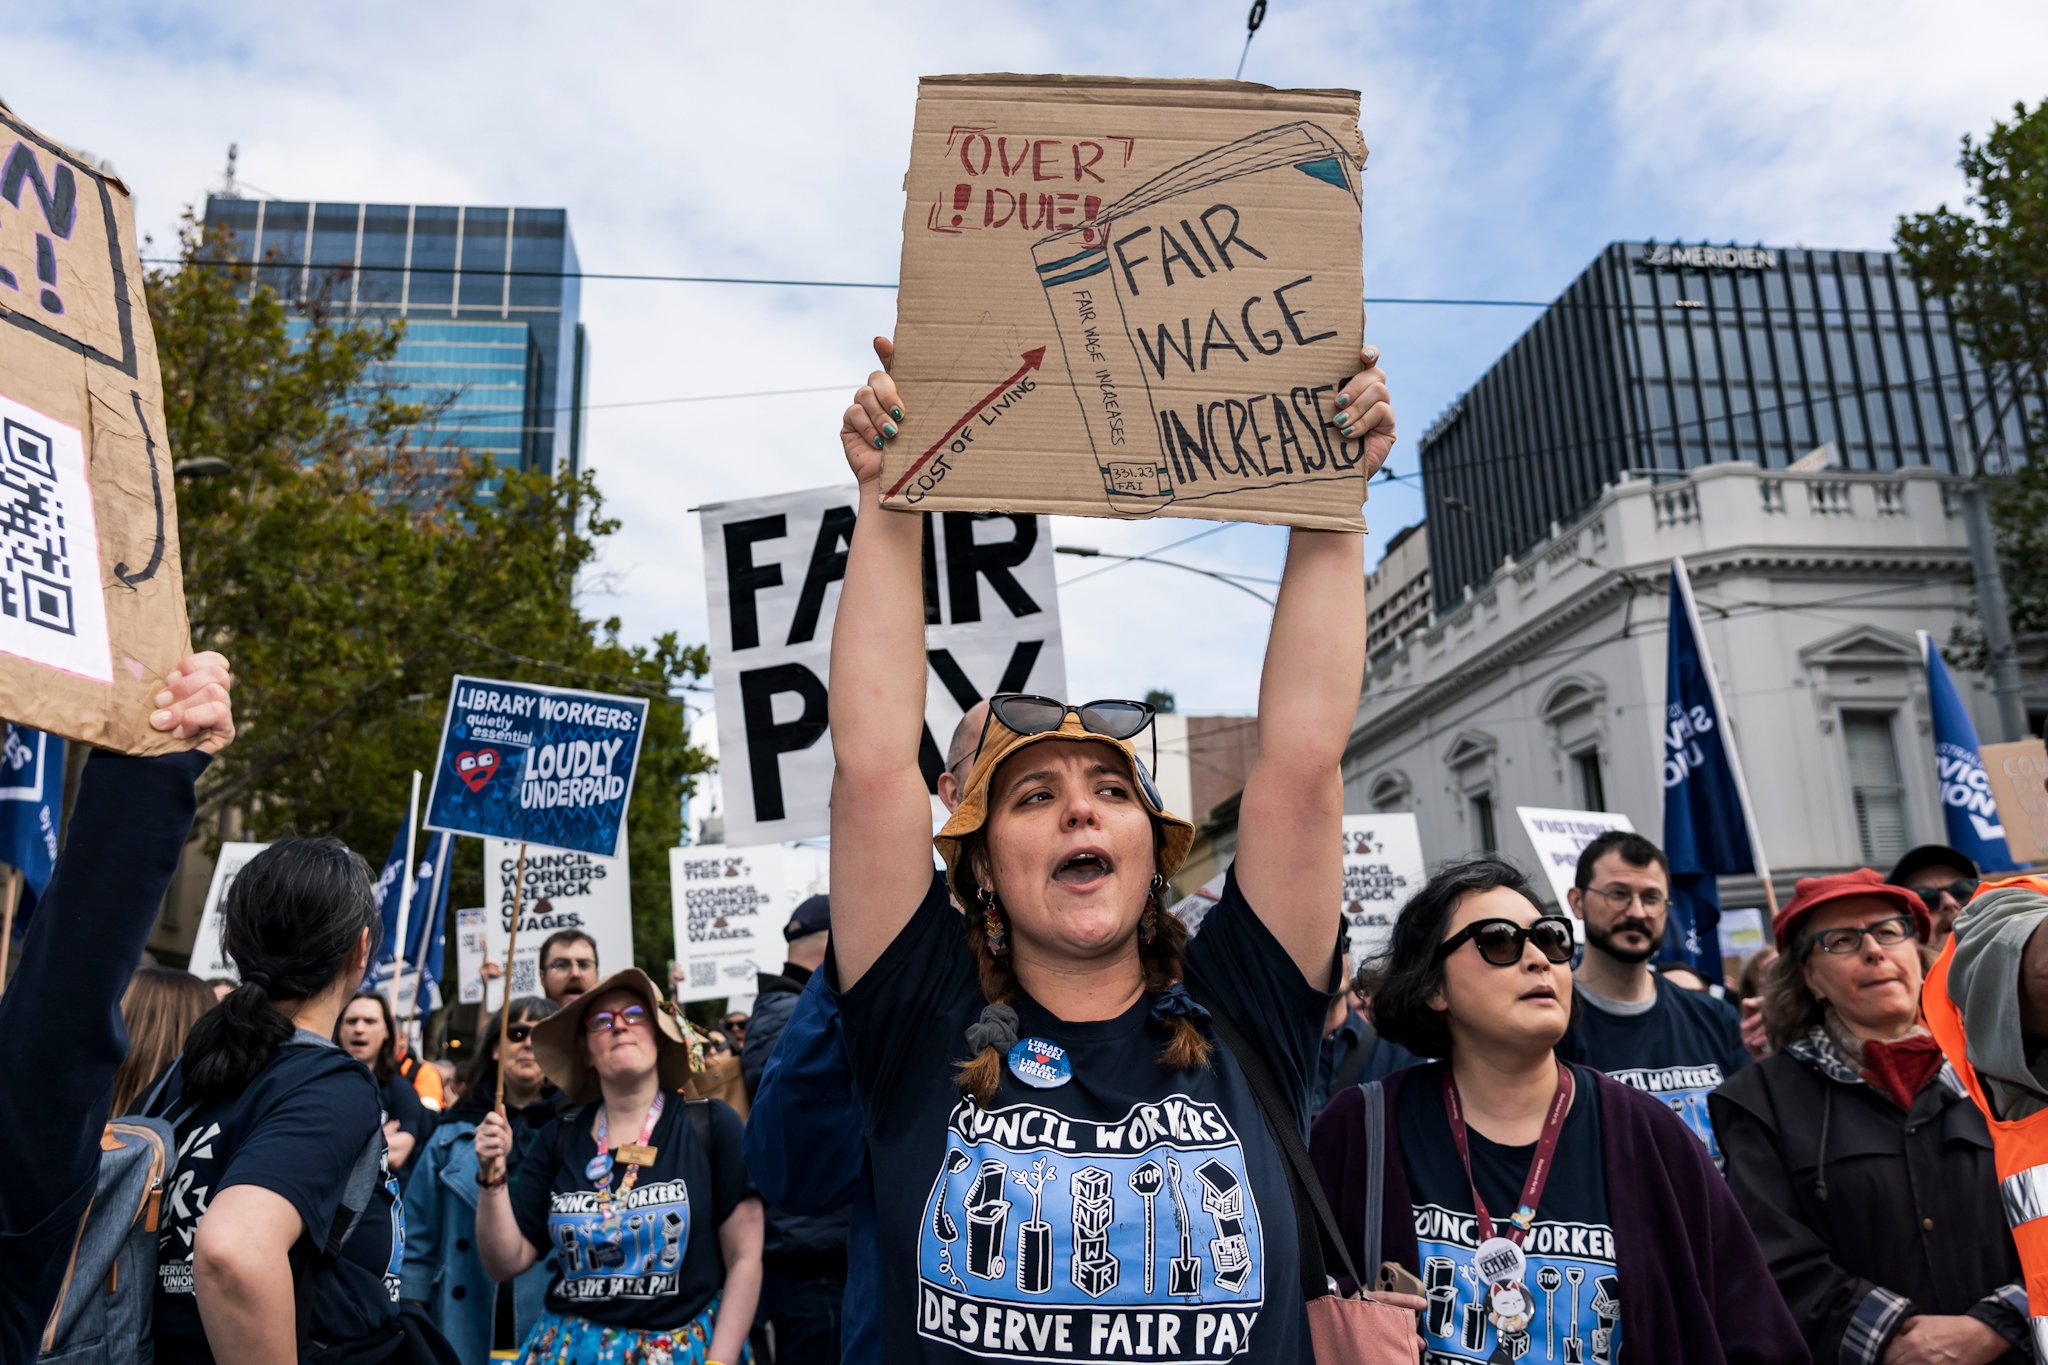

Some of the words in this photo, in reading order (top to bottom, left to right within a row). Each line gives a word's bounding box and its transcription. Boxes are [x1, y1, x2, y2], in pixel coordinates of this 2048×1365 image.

[960, 134, 1105, 183] OVER
[1113, 203, 1268, 296] FAIR
[1072, 289, 1097, 325] FAIR
[1136, 275, 1338, 380] WAGE
[1084, 326, 1106, 362] WAGE
[1095, 369, 1126, 446] INCREASES
[905, 454, 952, 504] COST
[950, 425, 975, 453] OF
[978, 376, 1037, 426] LIVING
[1112, 467, 1155, 479] 331.23
[1116, 482, 1144, 491] FAI
[457, 687, 537, 717] LIBRARY
[538, 696, 638, 731] WORKERS:
[466, 713, 513, 731] quietly
[739, 640, 1044, 823] PY
[472, 725, 533, 744] essential
[525, 737, 623, 781] LOUDLY
[520, 773, 625, 809] UNDERPAID
[1353, 831, 1374, 842] OF
[501, 853, 592, 872] COUNCIL
[684, 859, 720, 870] SICK
[1343, 865, 1393, 876] UNCIL
[501, 865, 607, 887] WORKERS
[685, 870, 720, 880] THIS
[502, 886, 540, 903] ARE
[543, 882, 592, 899] SICK
[685, 885, 758, 899] COUNCIL
[686, 894, 770, 909] WORKERS
[1355, 889, 1395, 901] SICK
[502, 903, 527, 918] OF
[688, 908, 717, 920] ARE
[720, 906, 758, 917] SICK
[502, 913, 584, 933] WAGES.
[1027, 1044, 1061, 1060] LOVERS
[1028, 1039, 1065, 1057] LIBRARY
[1018, 1064, 1057, 1082] WORKERS
[1020, 1058, 1058, 1074] LIBRARY
[1647, 1068, 1723, 1091] WORKERS
[1096, 1100, 1227, 1149] WORKERS
[1131, 1168, 1160, 1186] STOP
[629, 1183, 685, 1208] ORKERS
[1521, 1226, 1616, 1260] WORKER
[1538, 1272, 1560, 1285] STOP
[924, 1289, 1073, 1352] DESERVE
[1090, 1313, 1181, 1355] FAIR
[1195, 1311, 1259, 1355] PAY
